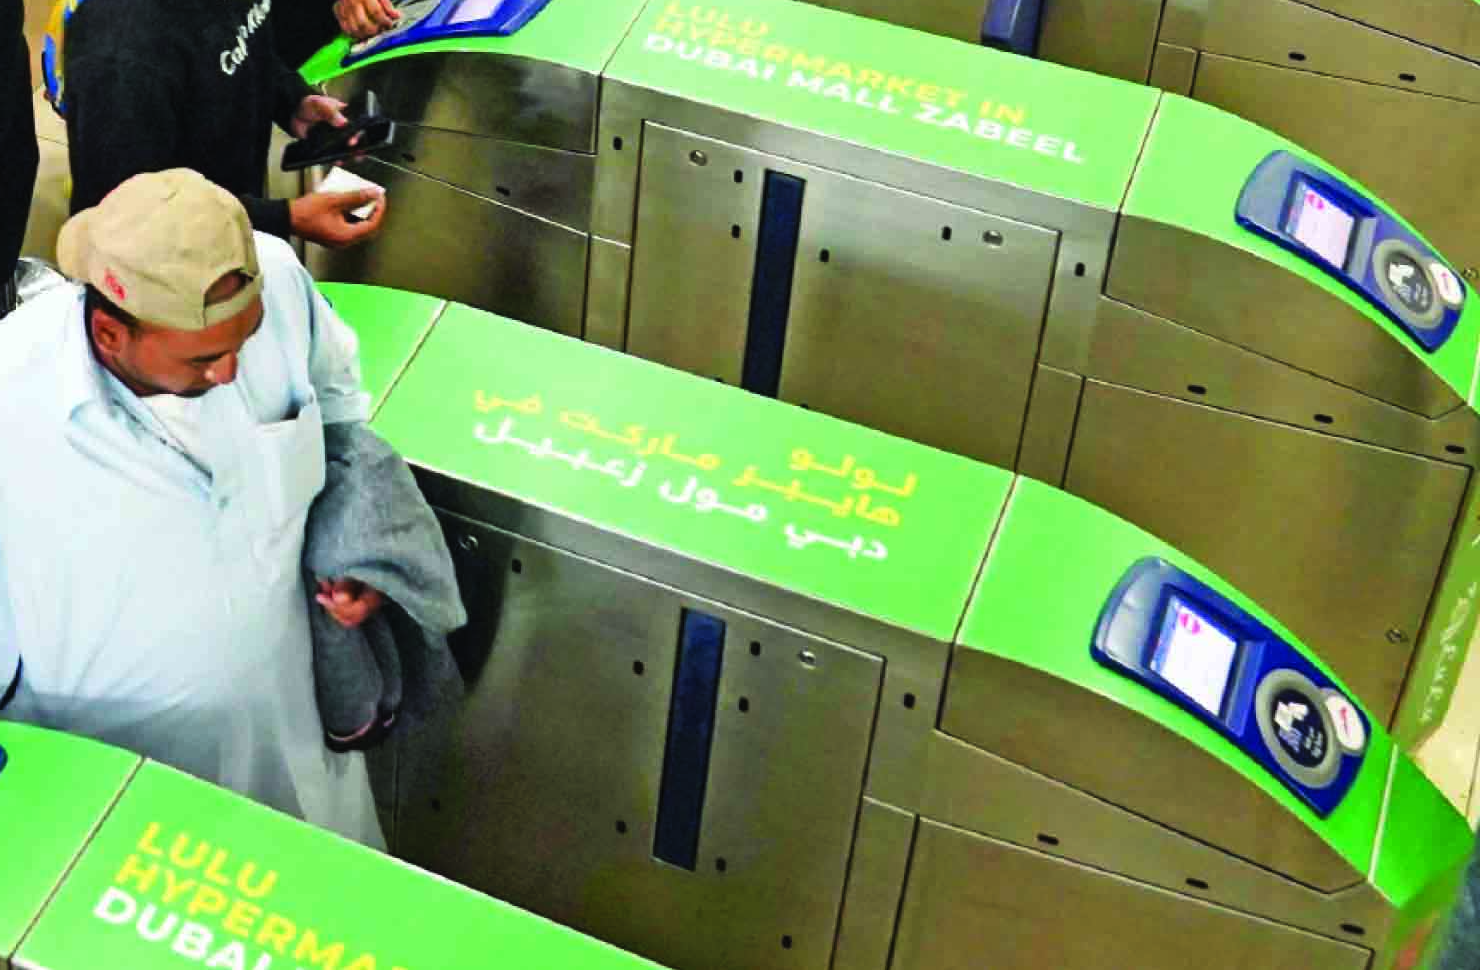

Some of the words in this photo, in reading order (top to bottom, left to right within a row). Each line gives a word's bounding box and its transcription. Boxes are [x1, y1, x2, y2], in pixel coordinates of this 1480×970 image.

[645, 33, 777, 80] DUBAI
[786, 70, 901, 115] MALL
[911, 102, 1086, 164] ZABEEL
[654, 13, 969, 109] HYPERMARKET
[977, 100, 1027, 126] IN
[473, 417, 648, 488] زعبيل
[789, 448, 917, 497] لولو
[658, 475, 769, 523] مول
[785, 523, 889, 560] دبي
[136, 821, 278, 898] LULU
